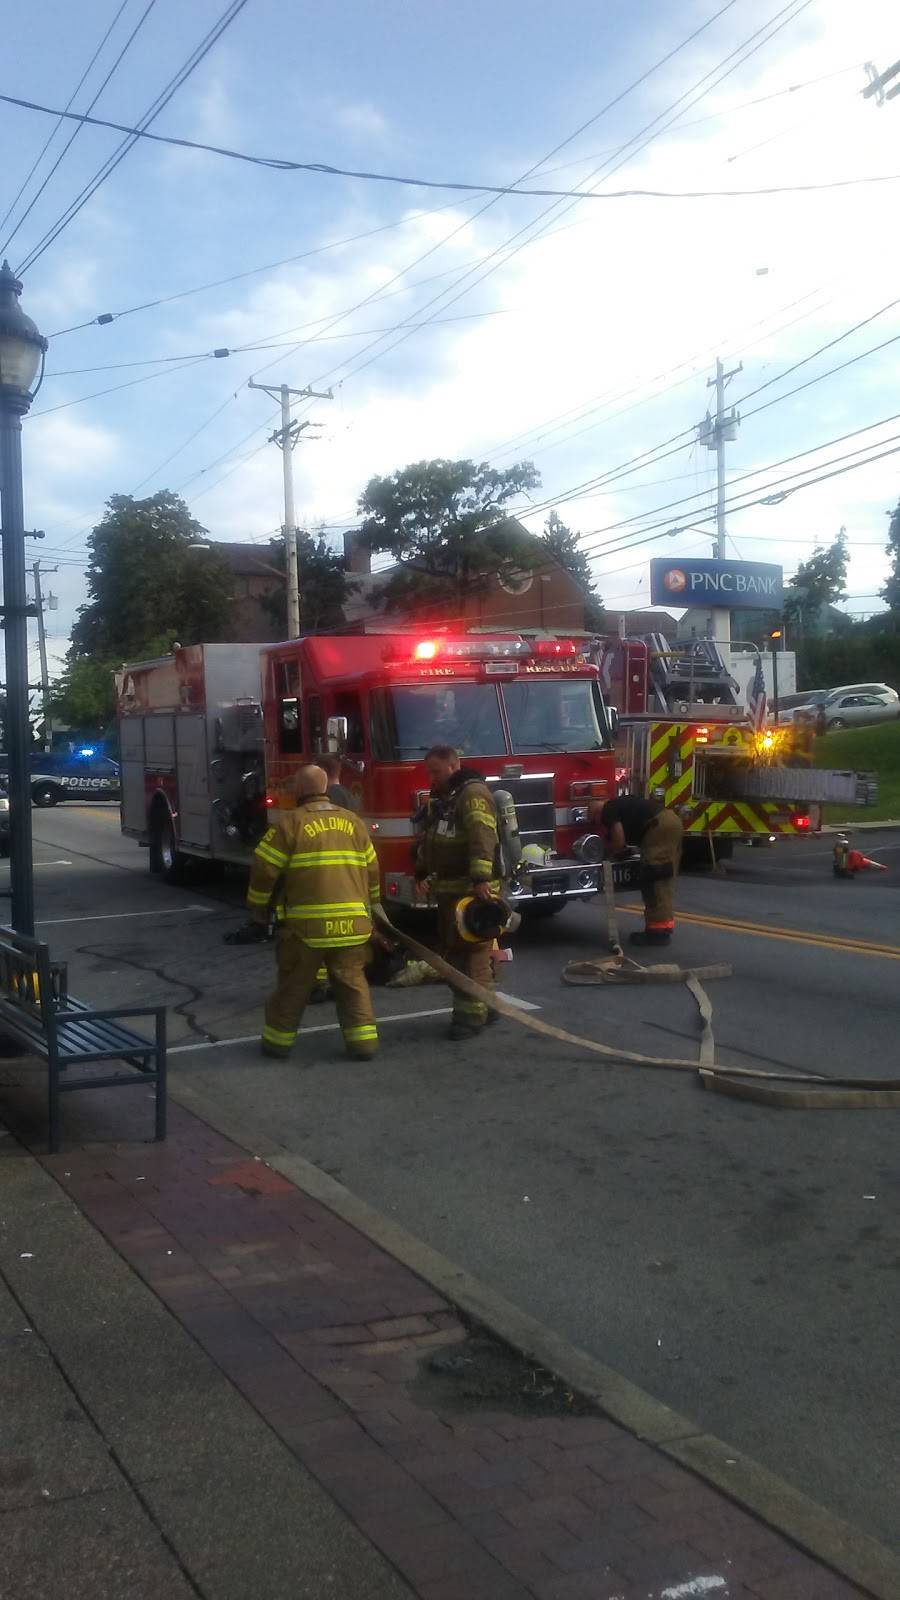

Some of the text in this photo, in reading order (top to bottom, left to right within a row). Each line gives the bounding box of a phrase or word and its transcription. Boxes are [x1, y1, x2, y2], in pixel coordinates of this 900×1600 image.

[689, 572, 777, 595] PNC BANK
[420, 668, 455, 676] FIRE
[526, 665, 580, 673] RESCUE
[60, 776, 107, 788] POLICE
[304, 817, 355, 838] BALDWIN
[326, 920, 354, 935] PACK
